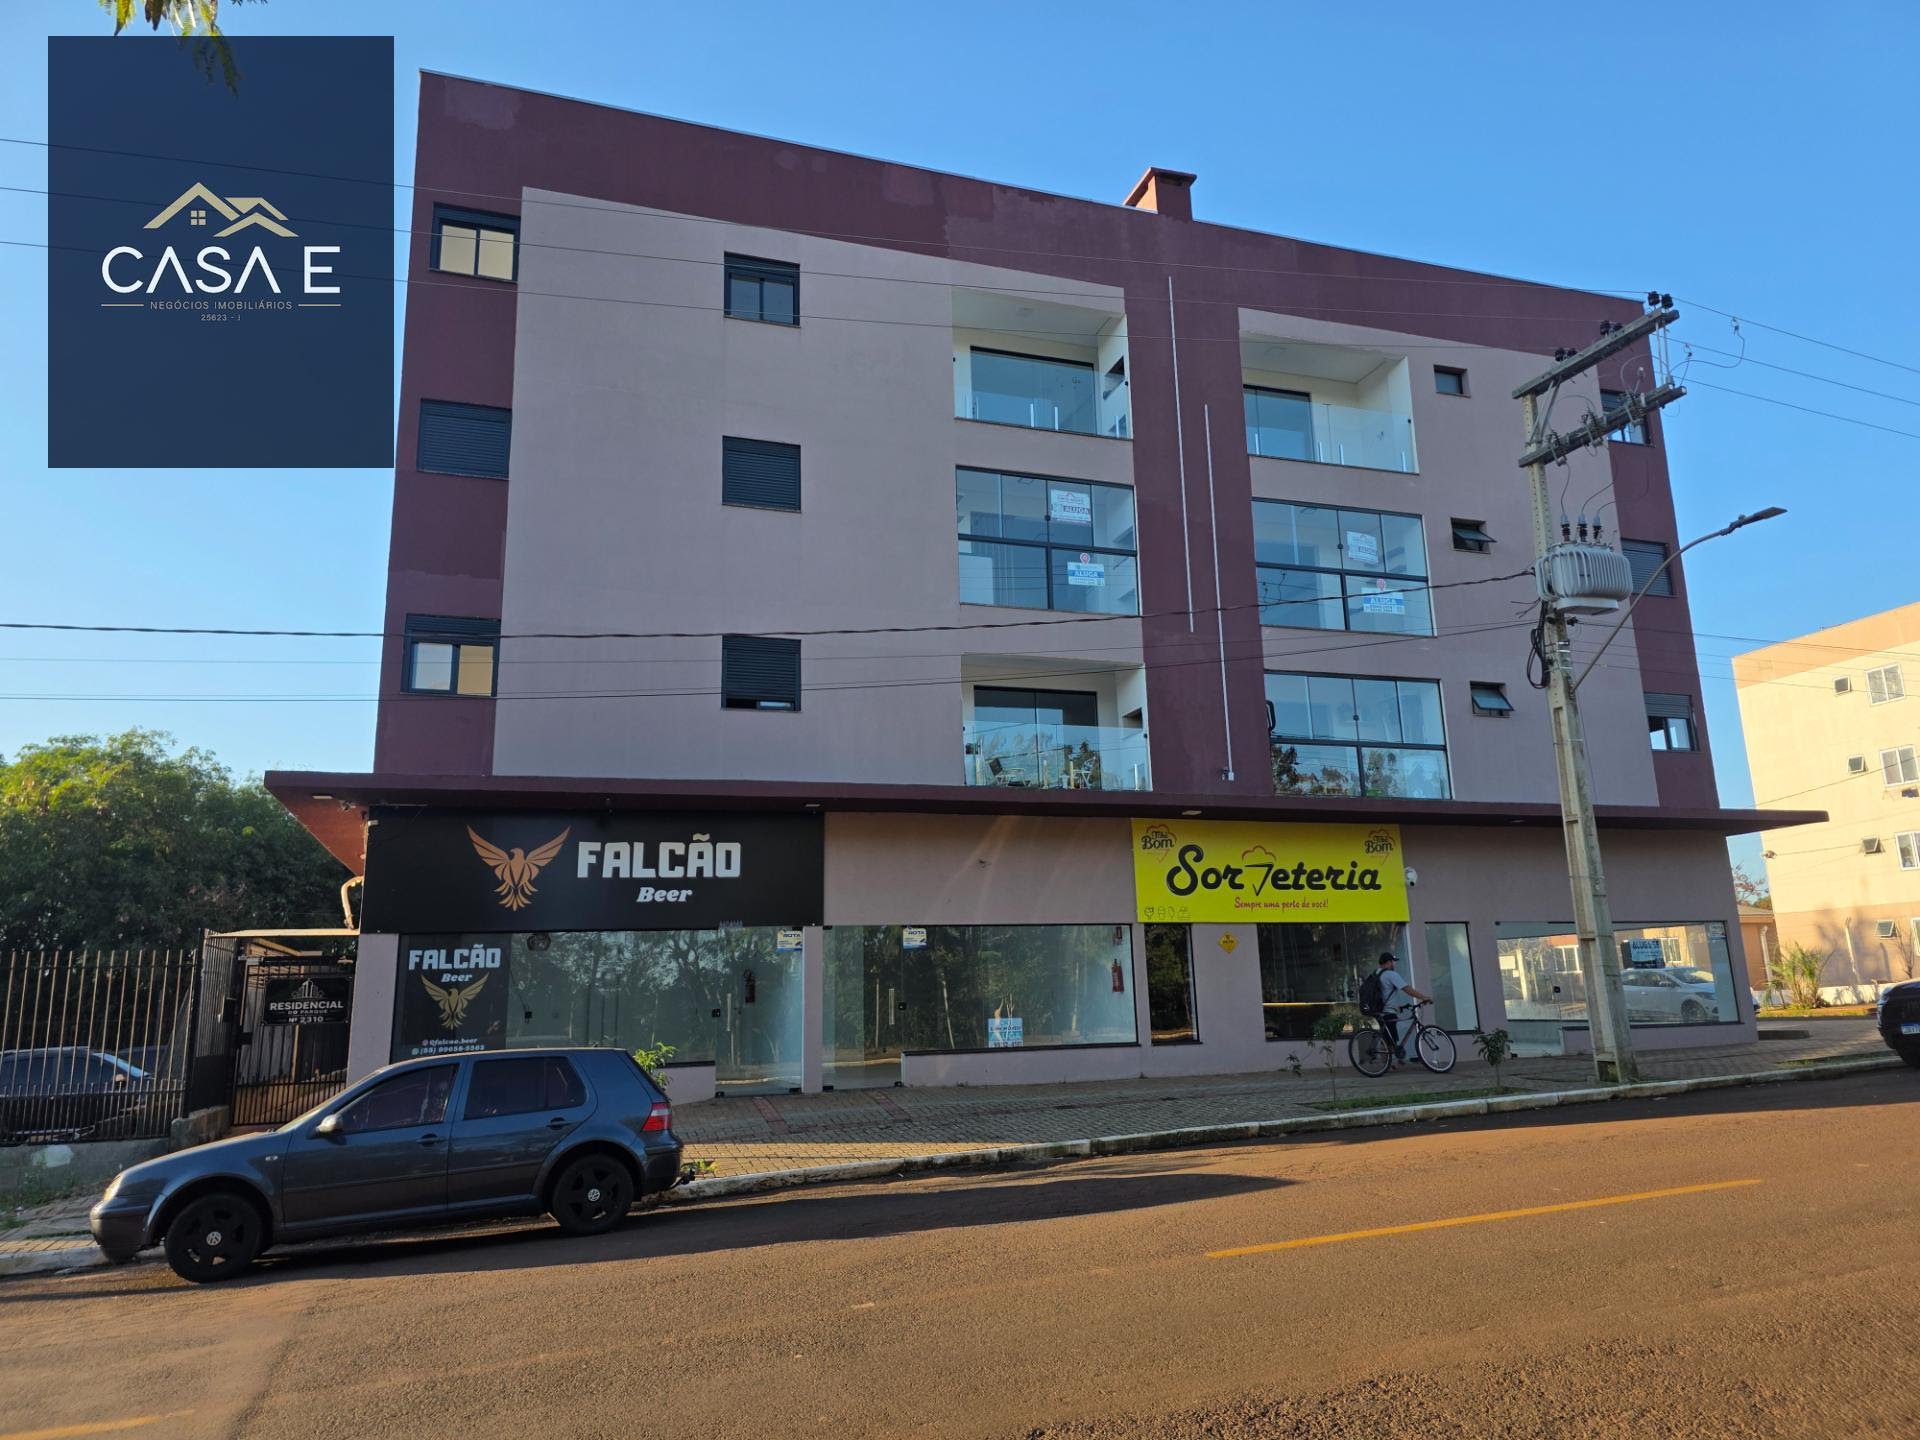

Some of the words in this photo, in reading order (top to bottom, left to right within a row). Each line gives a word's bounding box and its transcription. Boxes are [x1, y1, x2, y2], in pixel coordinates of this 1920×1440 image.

[1074, 570, 1098, 578] ALUGA
[1370, 597, 1396, 605] ALUGA
[1141, 835, 1175, 850] Bom
[1364, 840, 1394, 854] Bom
[577, 832, 742, 879] FALCÃO
[636, 886, 693, 903] Beer
[1234, 897, 1261, 911] Sempre
[1282, 900, 1299, 912] perto
[1301, 897, 1310, 908] de
[408, 943, 501, 970] FALCÃO
[441, 972, 473, 983] Beer
[269, 1000, 344, 1011] RESIDENCIAL
[300, 1016, 324, 1024] 2310
